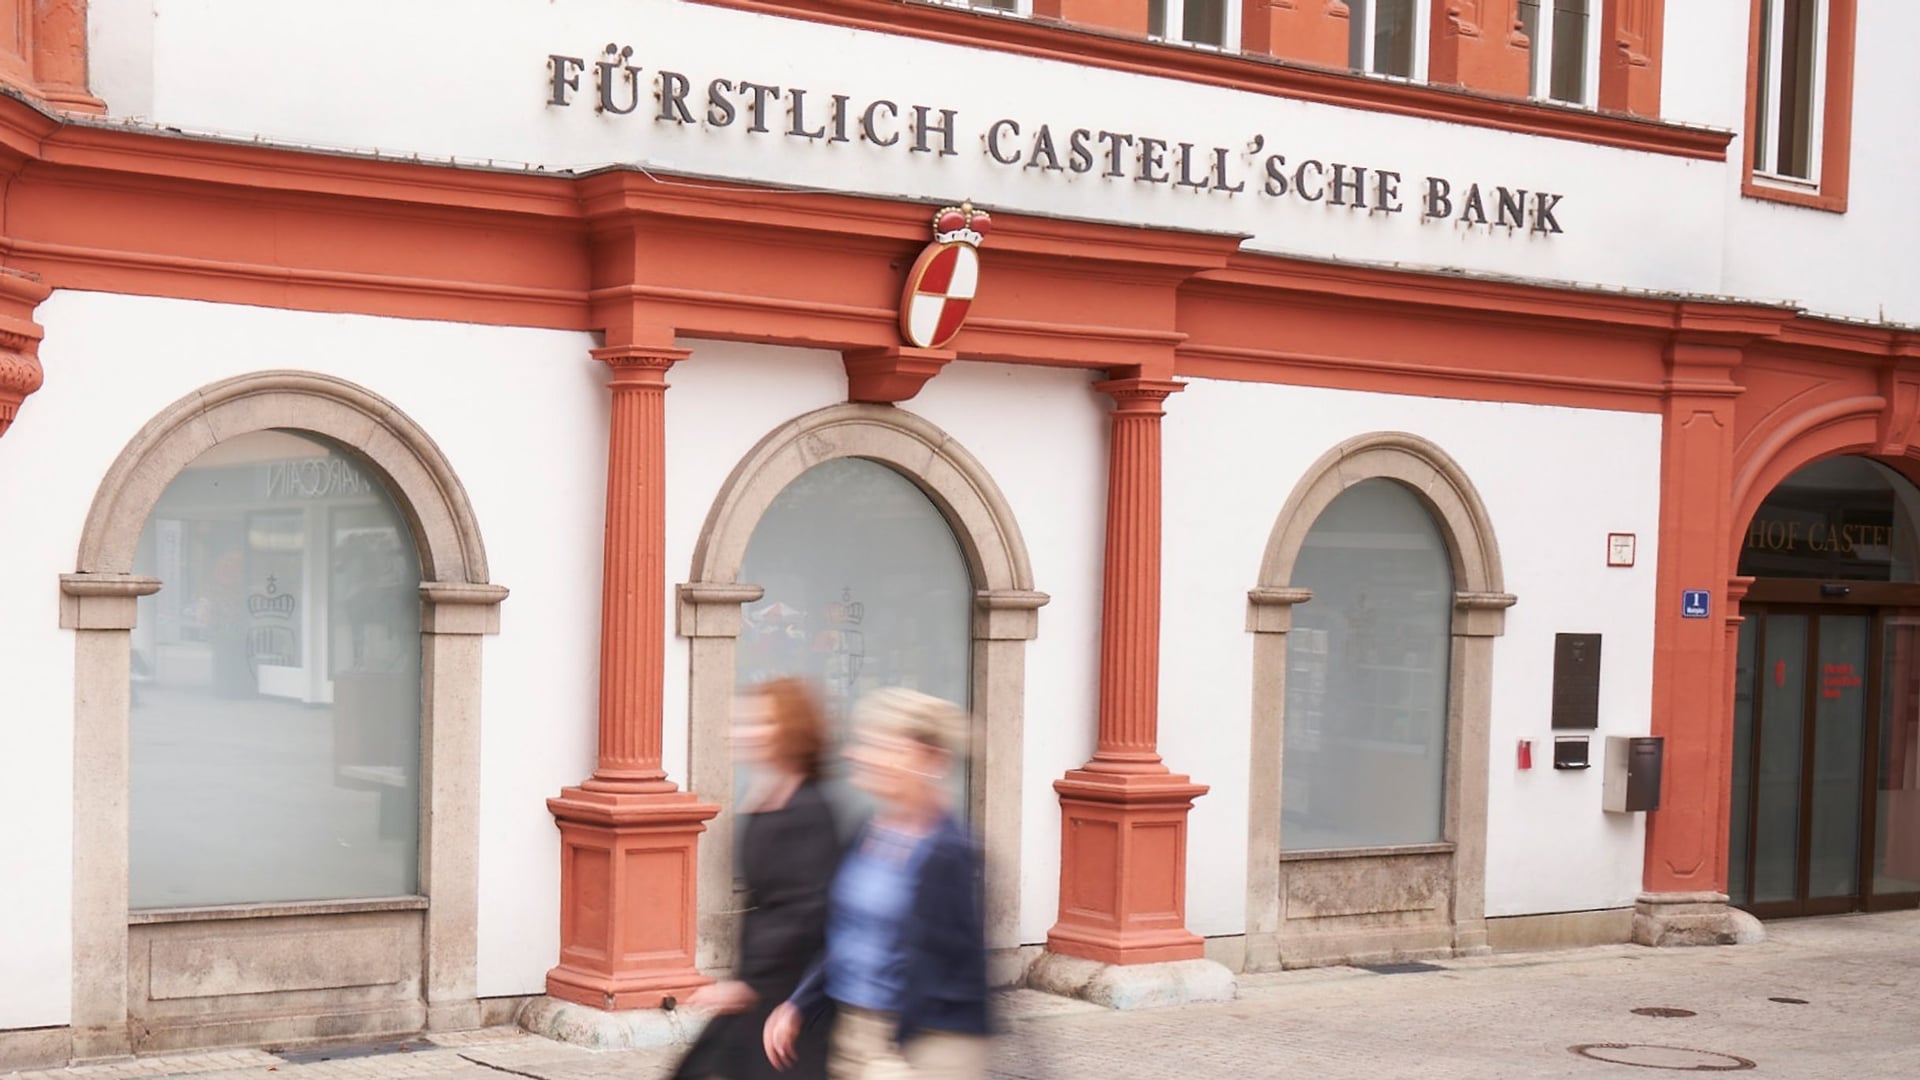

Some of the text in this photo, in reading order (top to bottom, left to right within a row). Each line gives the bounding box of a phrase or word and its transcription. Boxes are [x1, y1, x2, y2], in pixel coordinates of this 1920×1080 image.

[546, 43, 1564, 235] FÜRSTLICH CASTELL'SCHE BANK
[1693, 592, 1701, 607] 1
